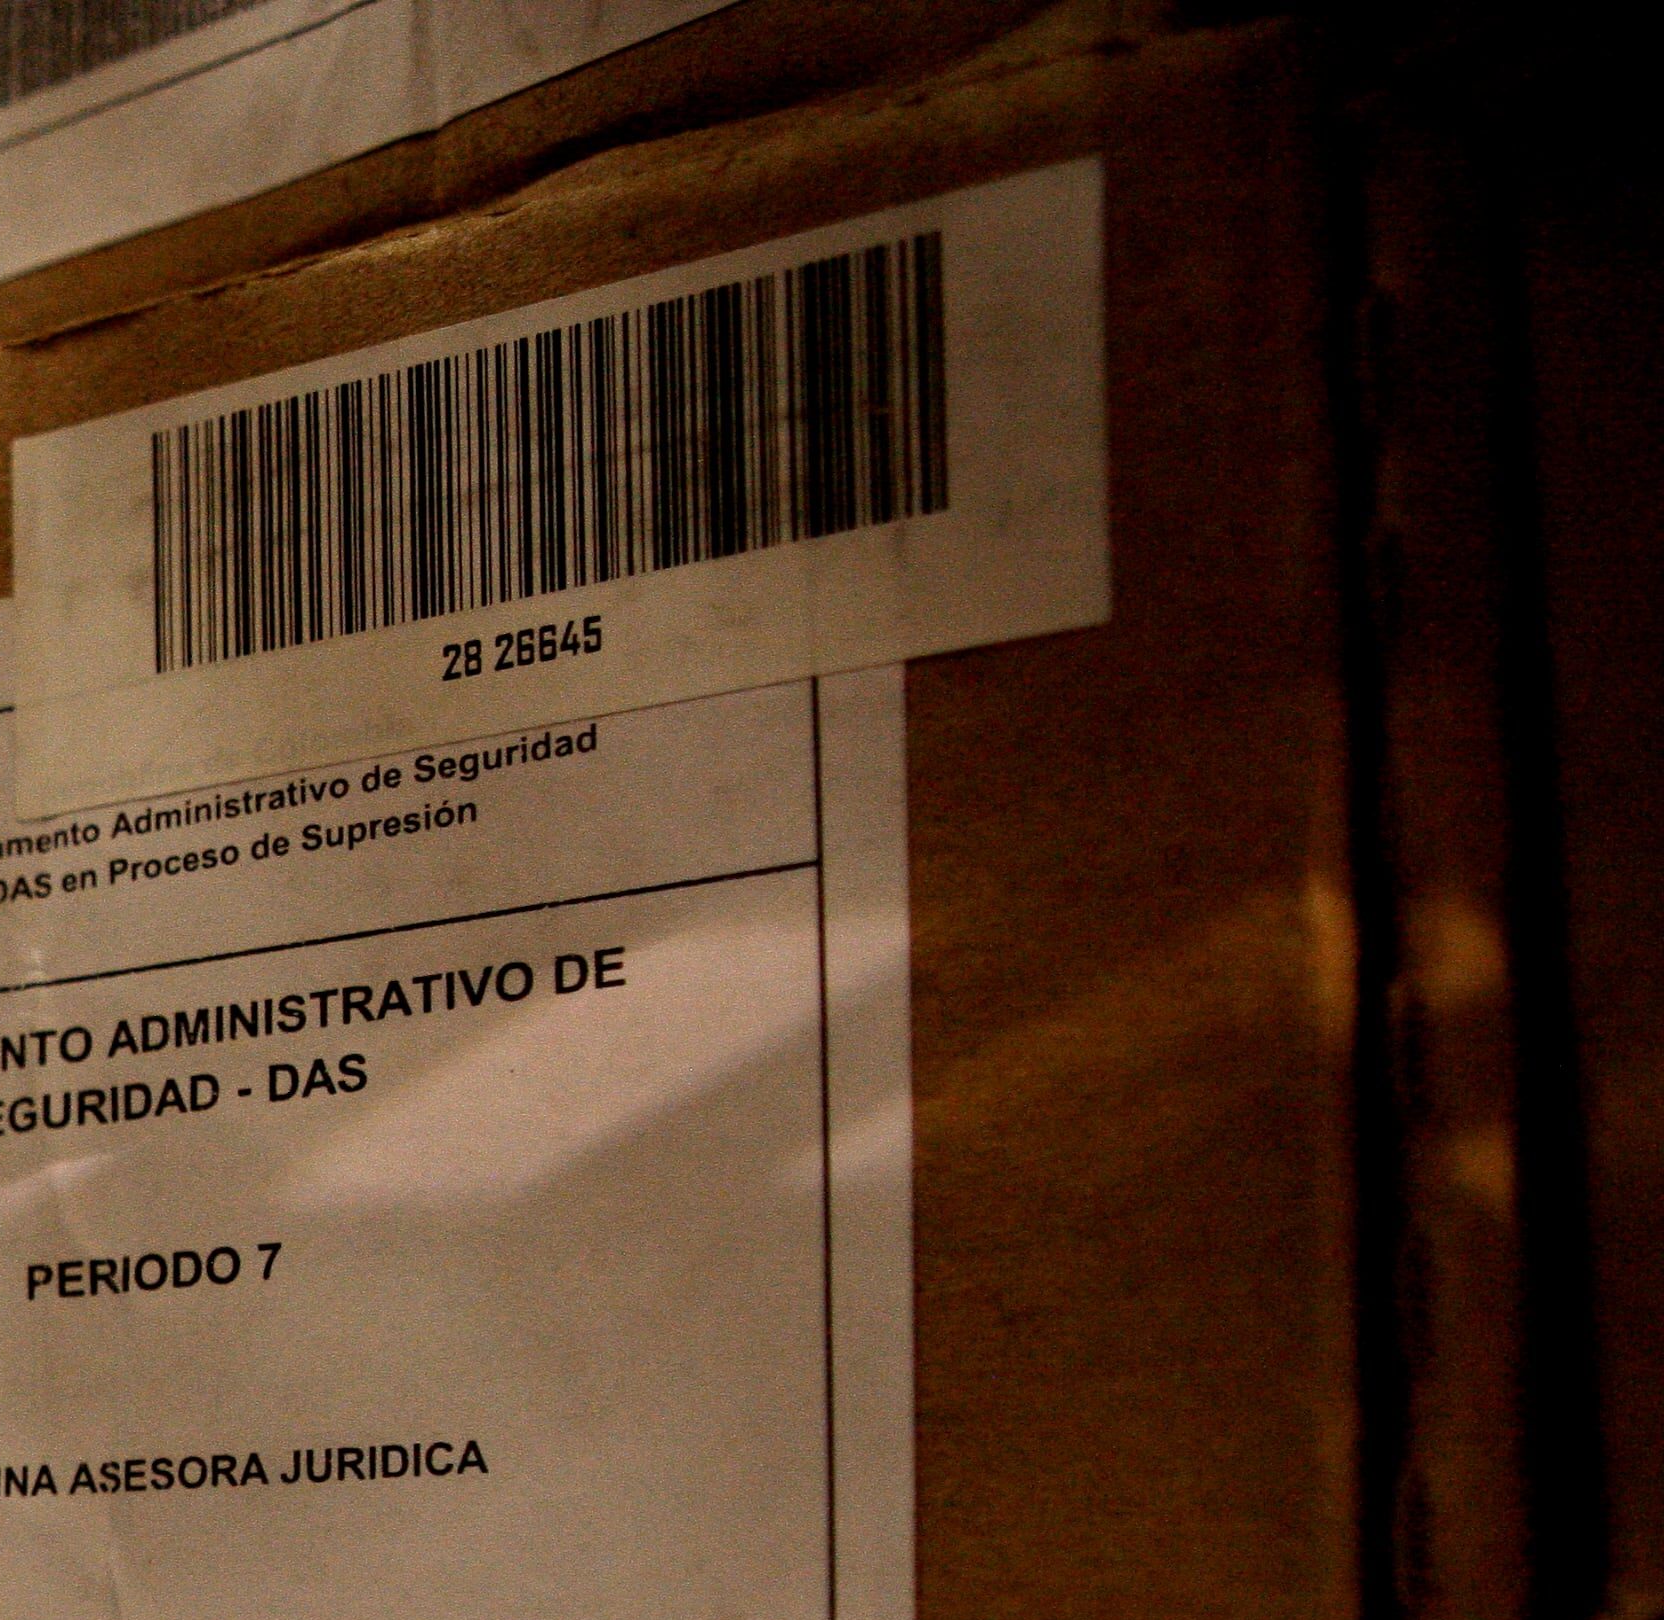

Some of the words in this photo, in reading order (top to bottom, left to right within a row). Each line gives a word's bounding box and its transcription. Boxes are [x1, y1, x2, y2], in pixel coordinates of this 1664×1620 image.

[442, 638, 483, 682] 28
[494, 614, 603, 672] 26645
[110, 774, 349, 840] Administrativo
[360, 764, 402, 794] de
[414, 722, 598, 784] Seguridad
[60, 868, 98, 894] en
[108, 844, 241, 885] Proceso
[250, 832, 291, 861] de
[300, 794, 479, 852] Supresión
[106, 959, 535, 1059] ADMINISTRATIVO
[553, 945, 626, 995] DE
[268, 1053, 368, 1103] DAS
[27, 1245, 242, 1301] PERIODO
[257, 1241, 282, 1281] 7
[69, 1452, 269, 1495] ASESORA
[280, 1439, 489, 1485] JURIDICA
